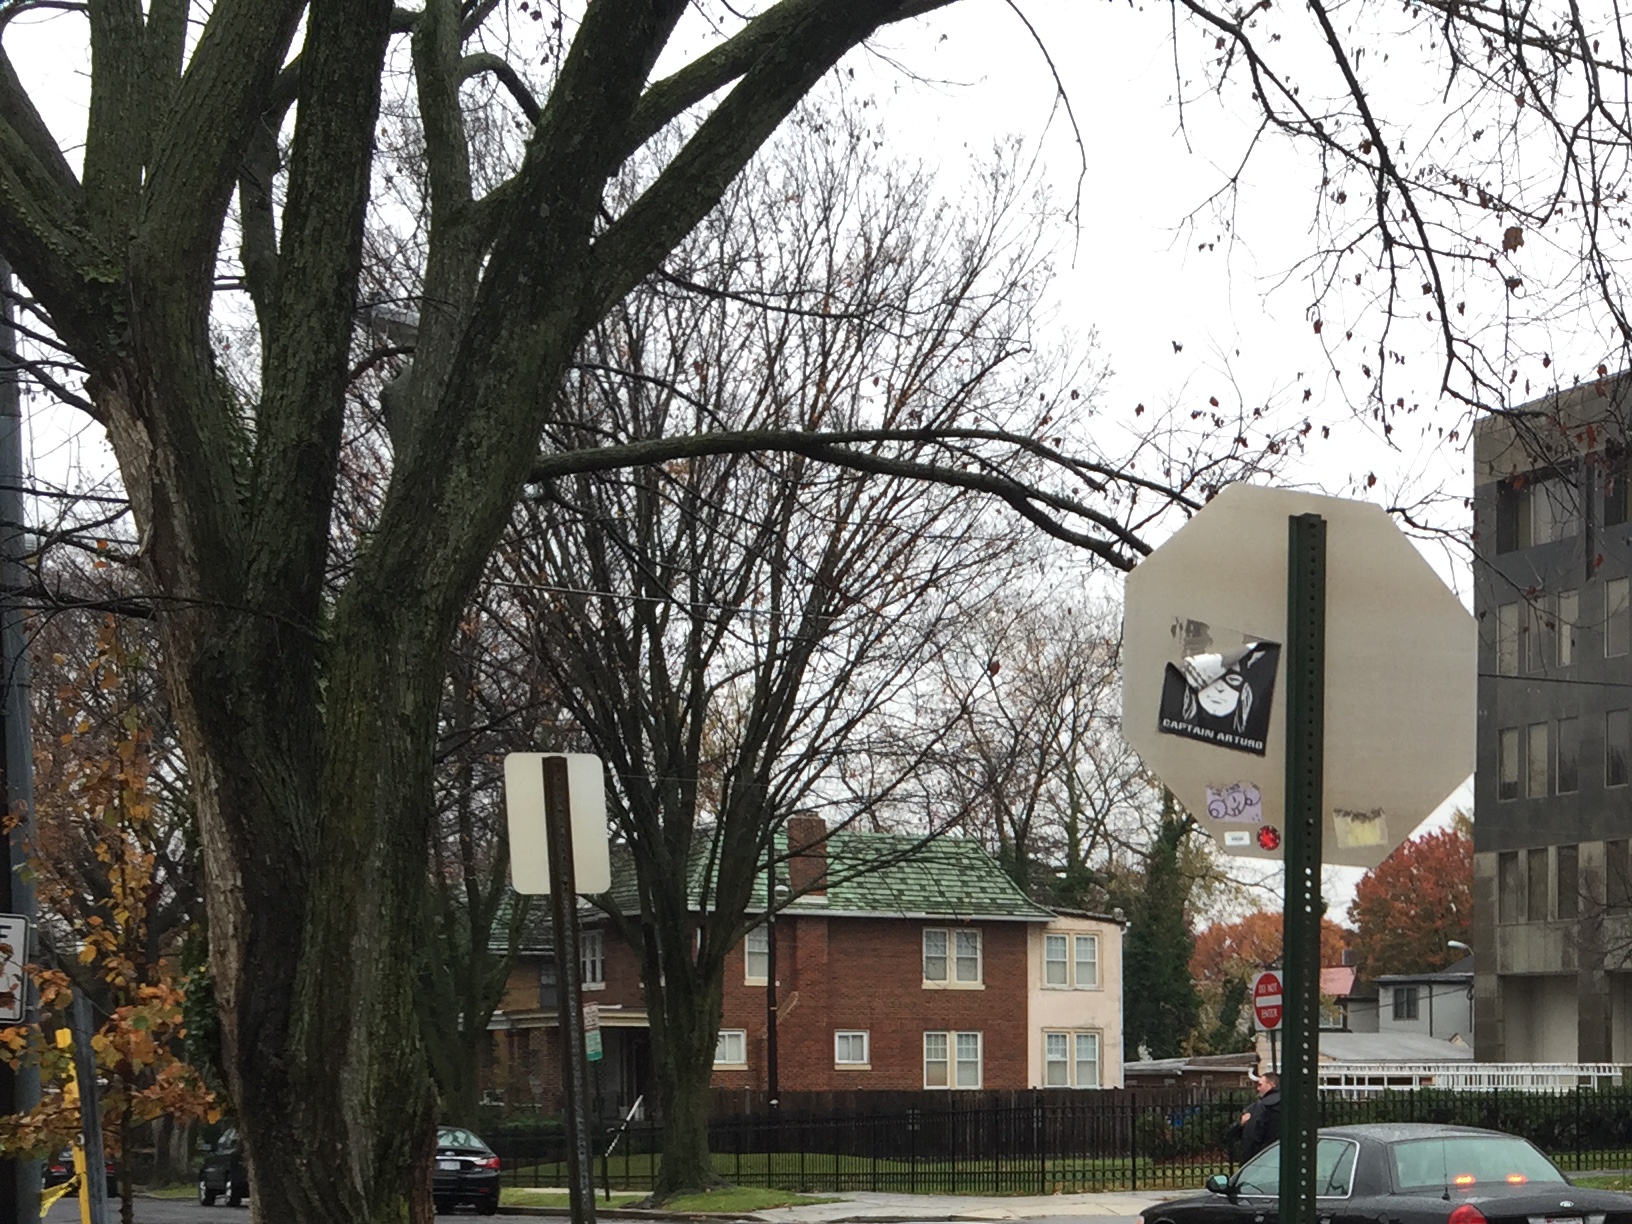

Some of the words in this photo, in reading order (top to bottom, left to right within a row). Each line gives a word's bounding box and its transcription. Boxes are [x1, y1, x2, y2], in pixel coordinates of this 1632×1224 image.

[1258, 984, 1267, 994] DO
[1267, 982, 1278, 993] NOT
[1261, 1008, 1278, 1018] ENTER
